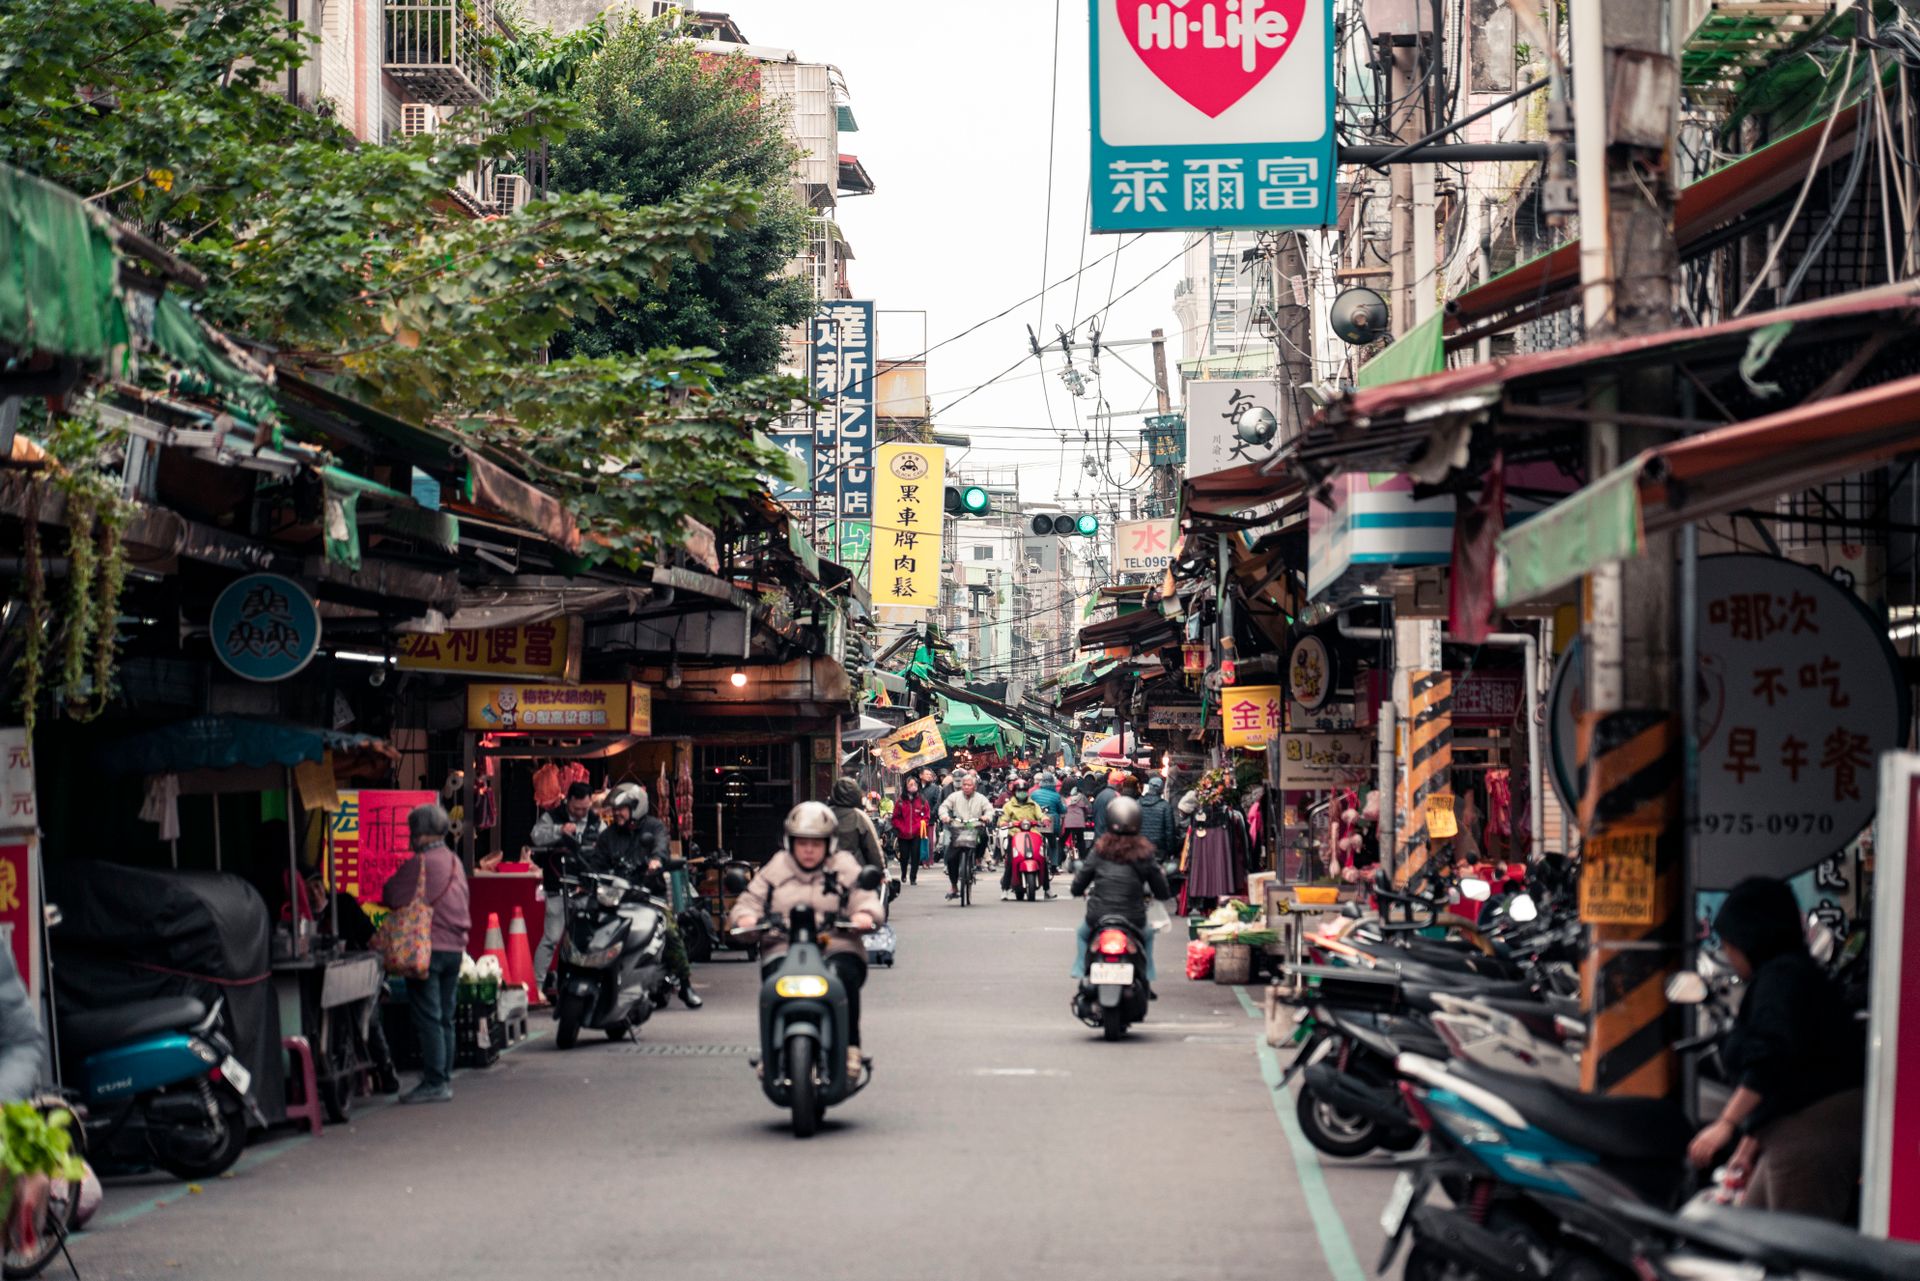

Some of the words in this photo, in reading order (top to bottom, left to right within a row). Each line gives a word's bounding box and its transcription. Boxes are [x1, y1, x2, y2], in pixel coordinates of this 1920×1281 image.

[1138, 0, 1288, 72] Hi-Life
[1109, 156, 1318, 213] 萊爾富
[892, 485, 920, 597] 黑車牌肉鬆
[1131, 523, 1167, 554] 水
[1709, 591, 1819, 641] 哪次
[1753, 655, 1850, 708] 不吃
[1724, 725, 1873, 802] 早午餐
